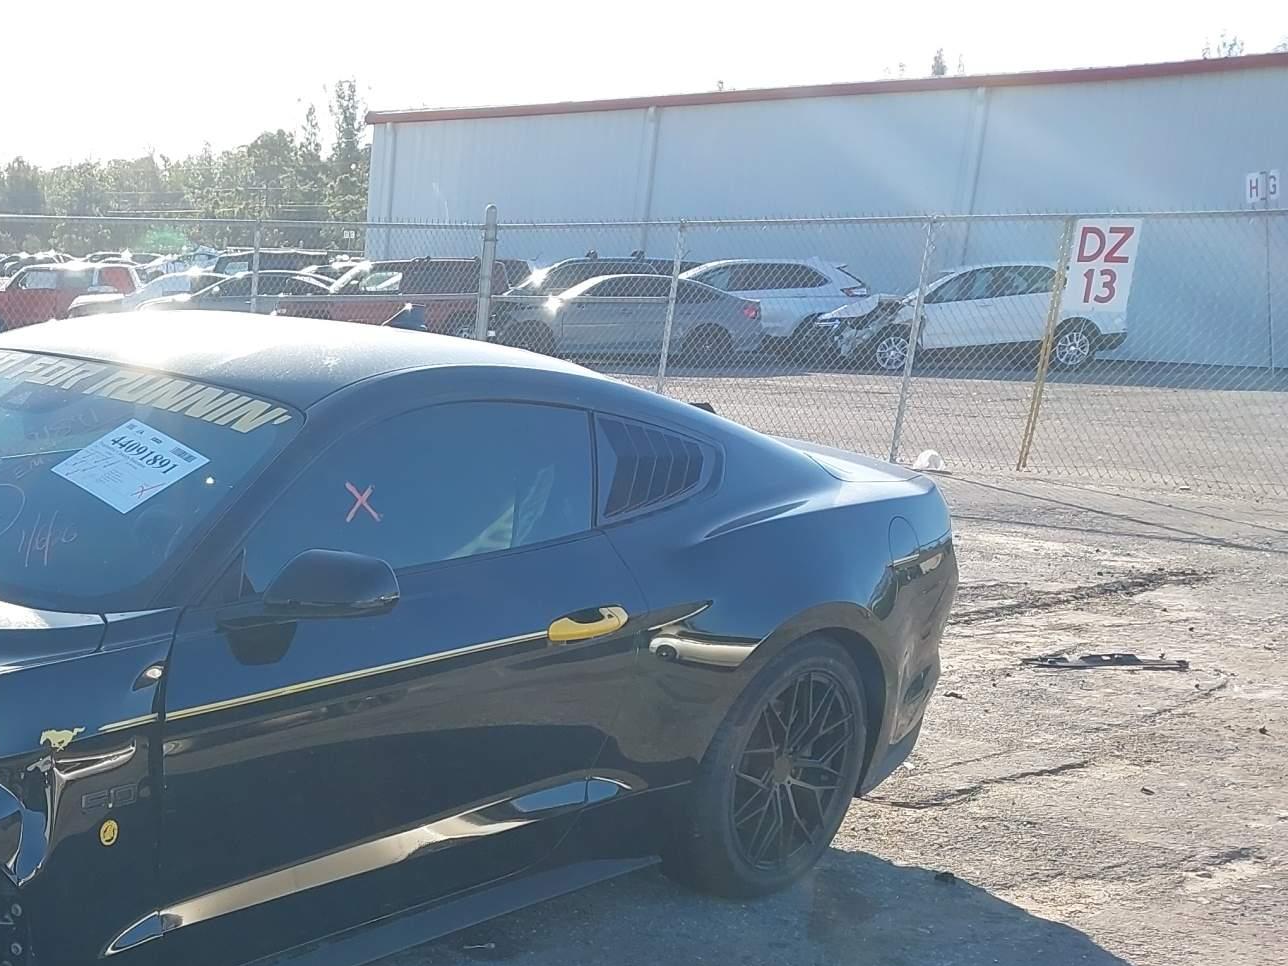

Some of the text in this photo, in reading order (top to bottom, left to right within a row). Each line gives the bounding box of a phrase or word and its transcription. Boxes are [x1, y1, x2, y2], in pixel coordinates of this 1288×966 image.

[1076, 226, 1136, 264] DZ
[1082, 268, 1118, 305] 13
[81, 366, 293, 434] RUNNIN'
[110, 435, 179, 475] 44091891
